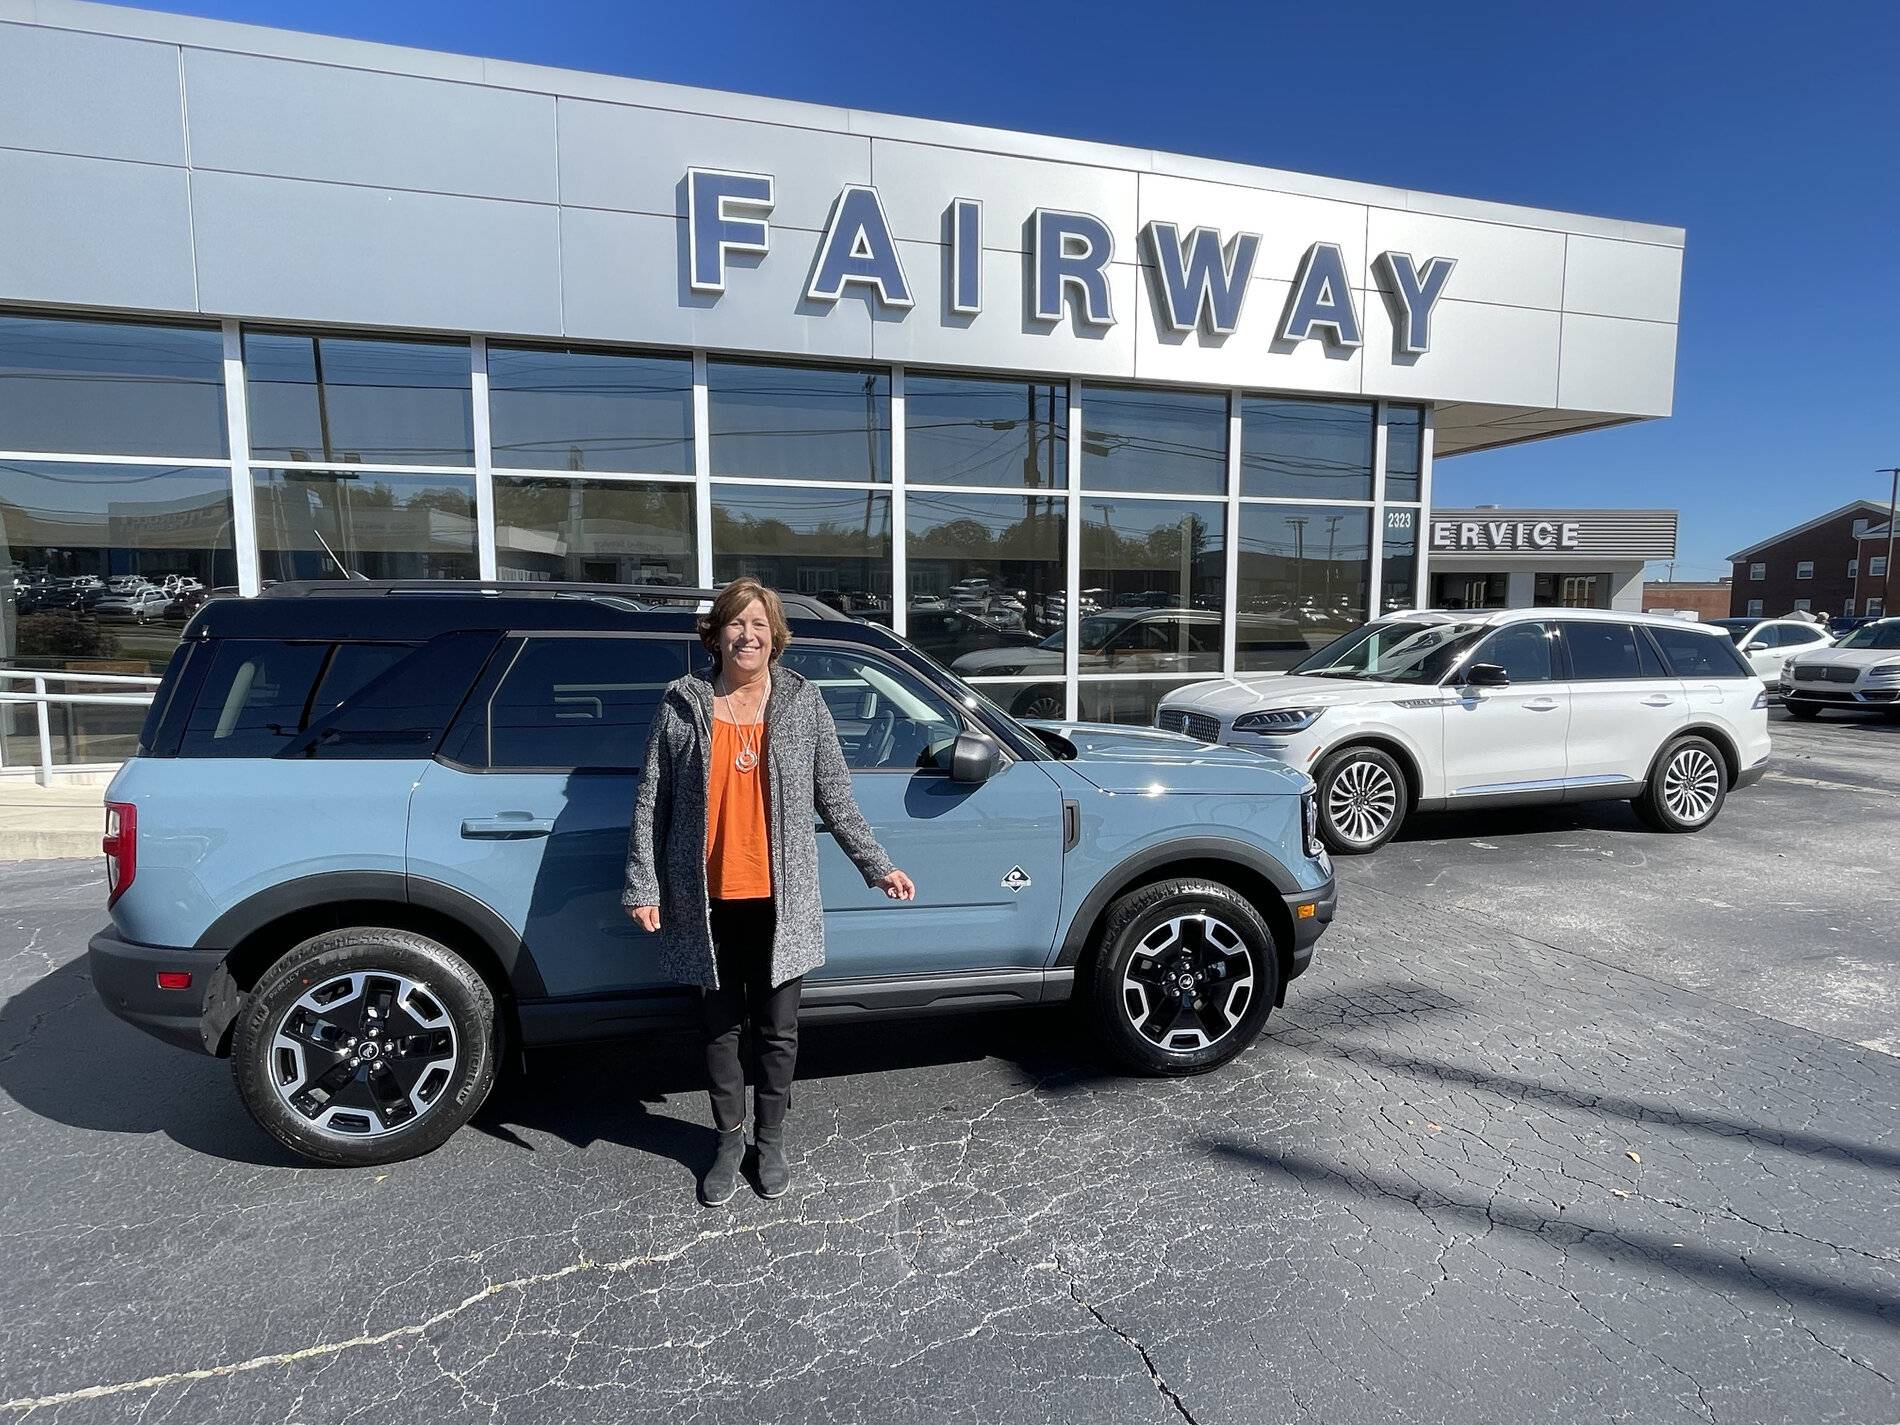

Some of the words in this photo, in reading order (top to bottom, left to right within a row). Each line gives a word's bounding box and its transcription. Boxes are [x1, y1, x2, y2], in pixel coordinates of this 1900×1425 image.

[686, 165, 1459, 354] FAIRWAY
[1388, 512, 1411, 528] 2323
[1434, 522, 1580, 546] ERVICE
